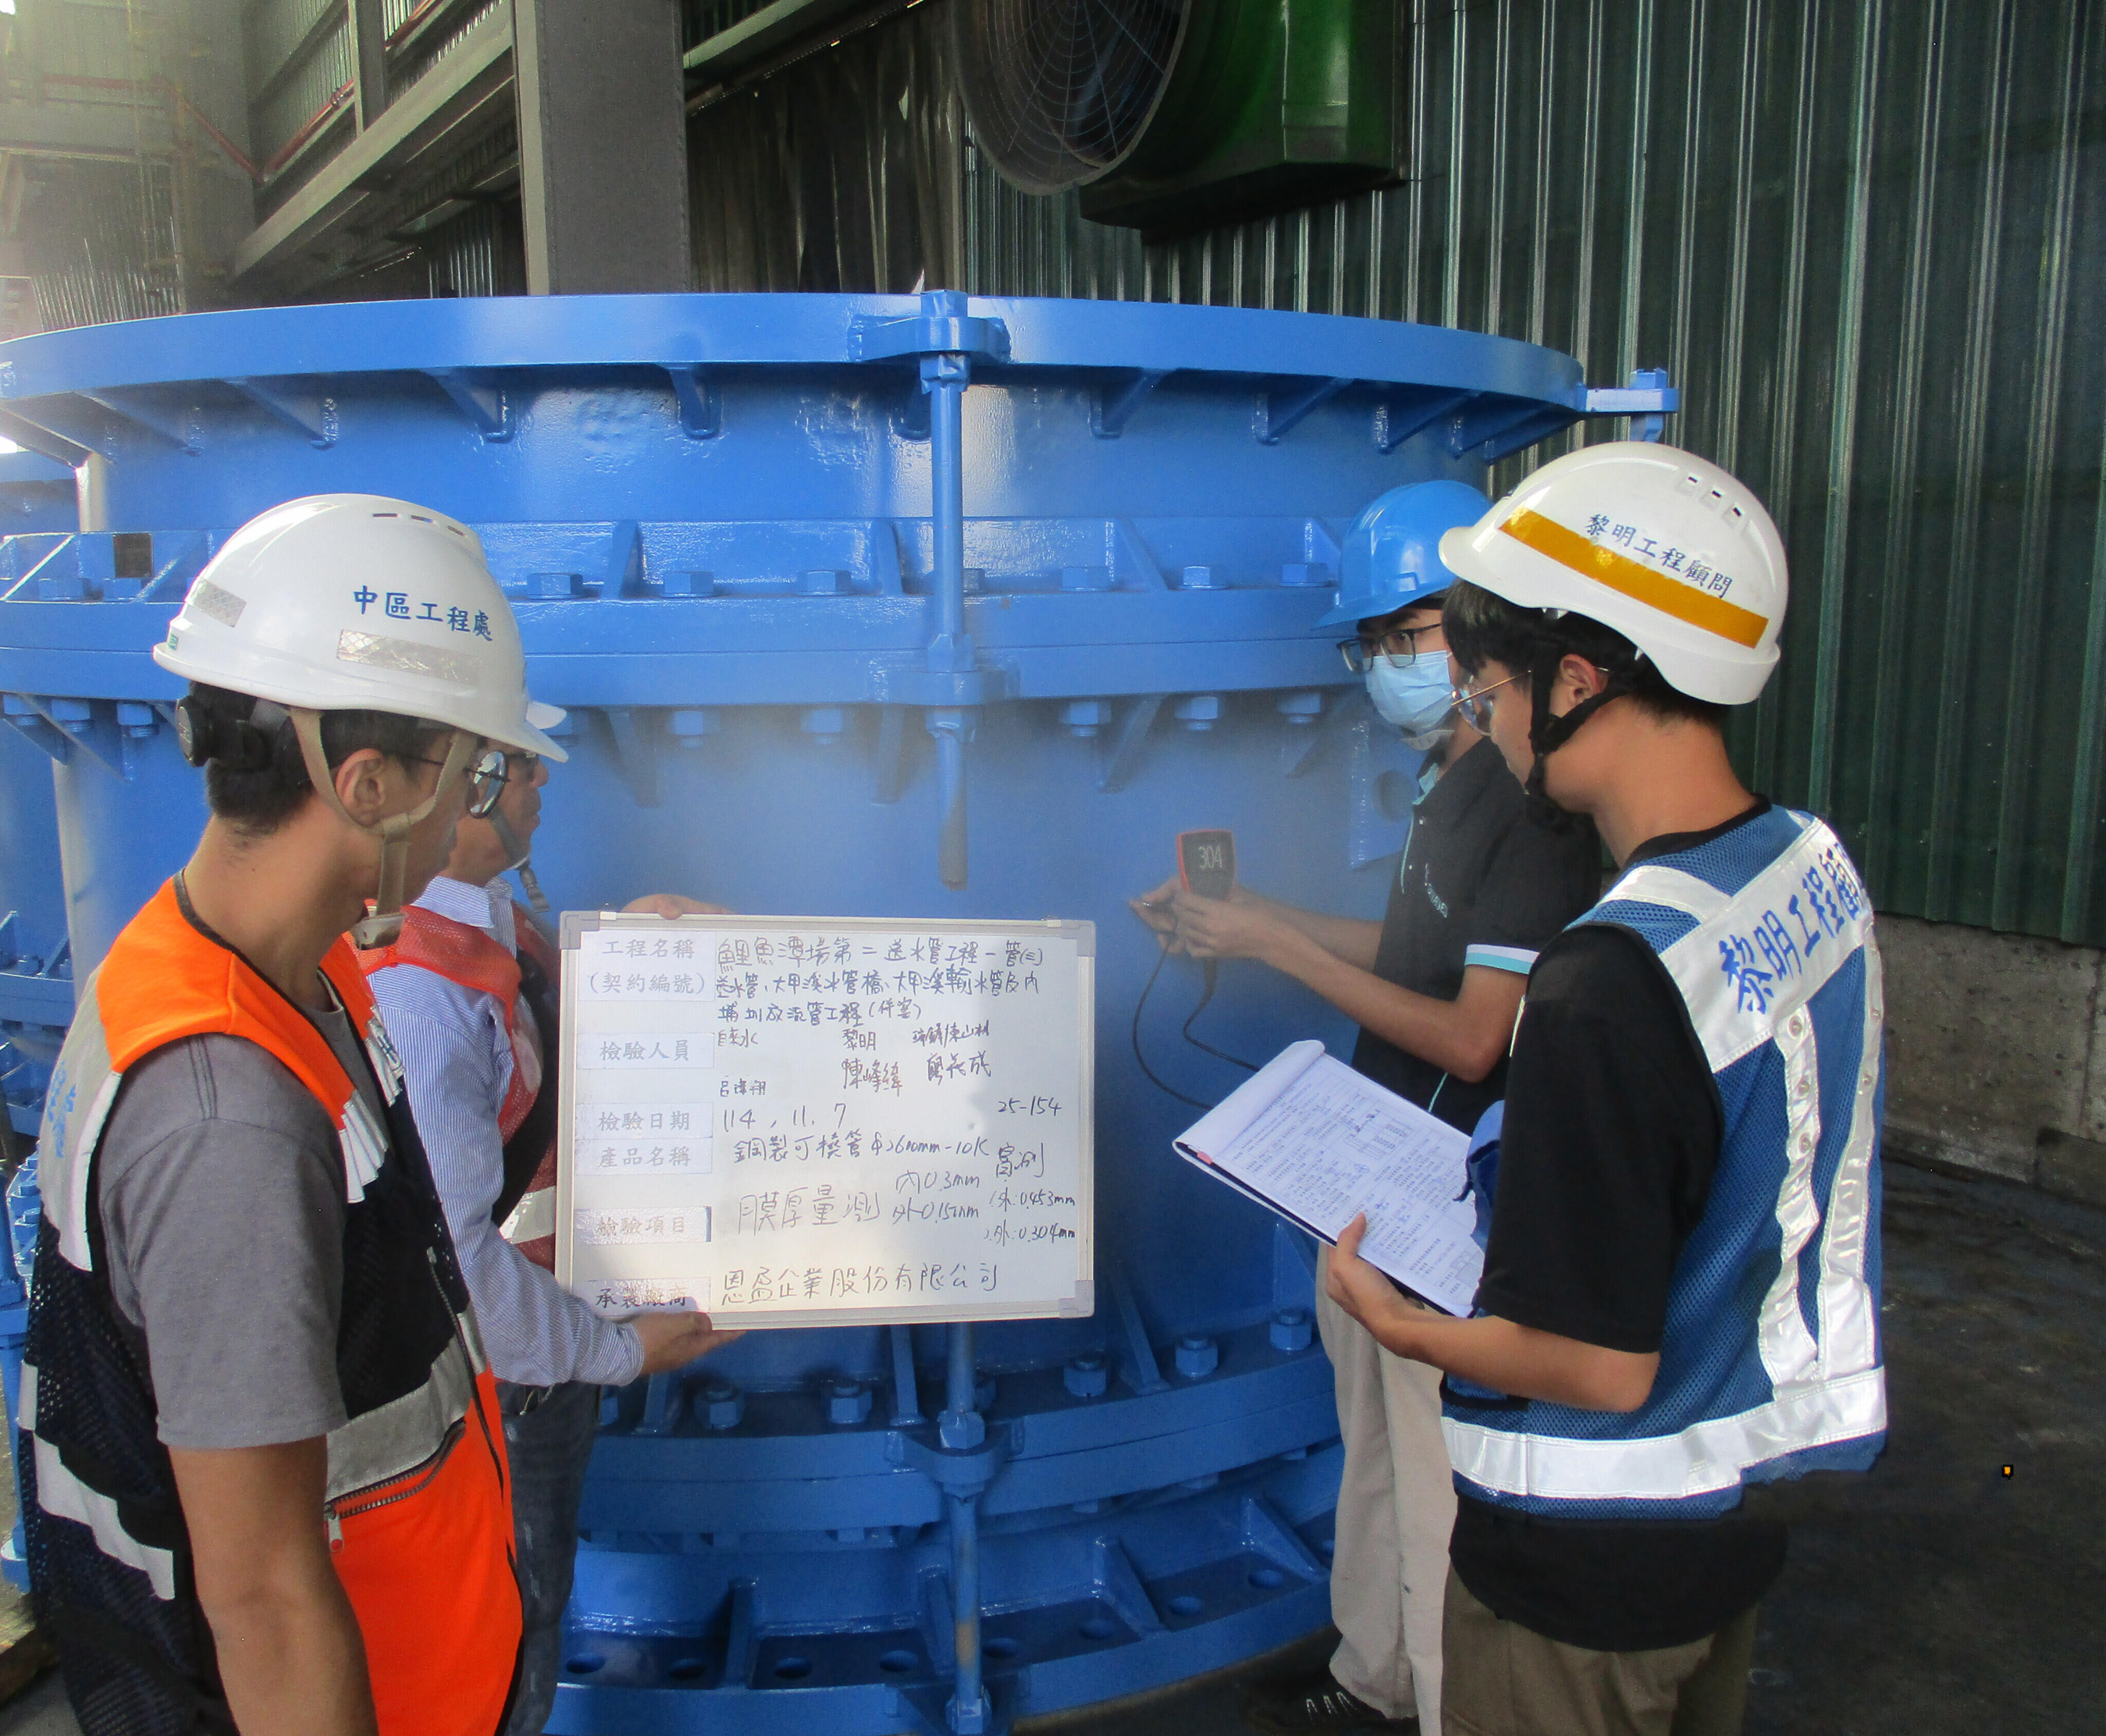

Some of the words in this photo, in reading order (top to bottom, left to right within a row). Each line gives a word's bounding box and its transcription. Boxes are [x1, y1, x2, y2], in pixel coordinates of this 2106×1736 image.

[1585, 513, 1733, 599] 黎明工程顧問
[353, 585, 493, 641] 中區工程處
[602, 938, 695, 959] 工程名稱
[590, 971, 705, 994] (契約編號)
[598, 1039, 689, 1061] 檢驗人員
[842, 1028, 876, 1051] 黎明
[997, 1095, 1062, 1116] 25-154
[597, 1110, 690, 1132] 檢驗日期
[597, 1146, 692, 1168] 產品名稱
